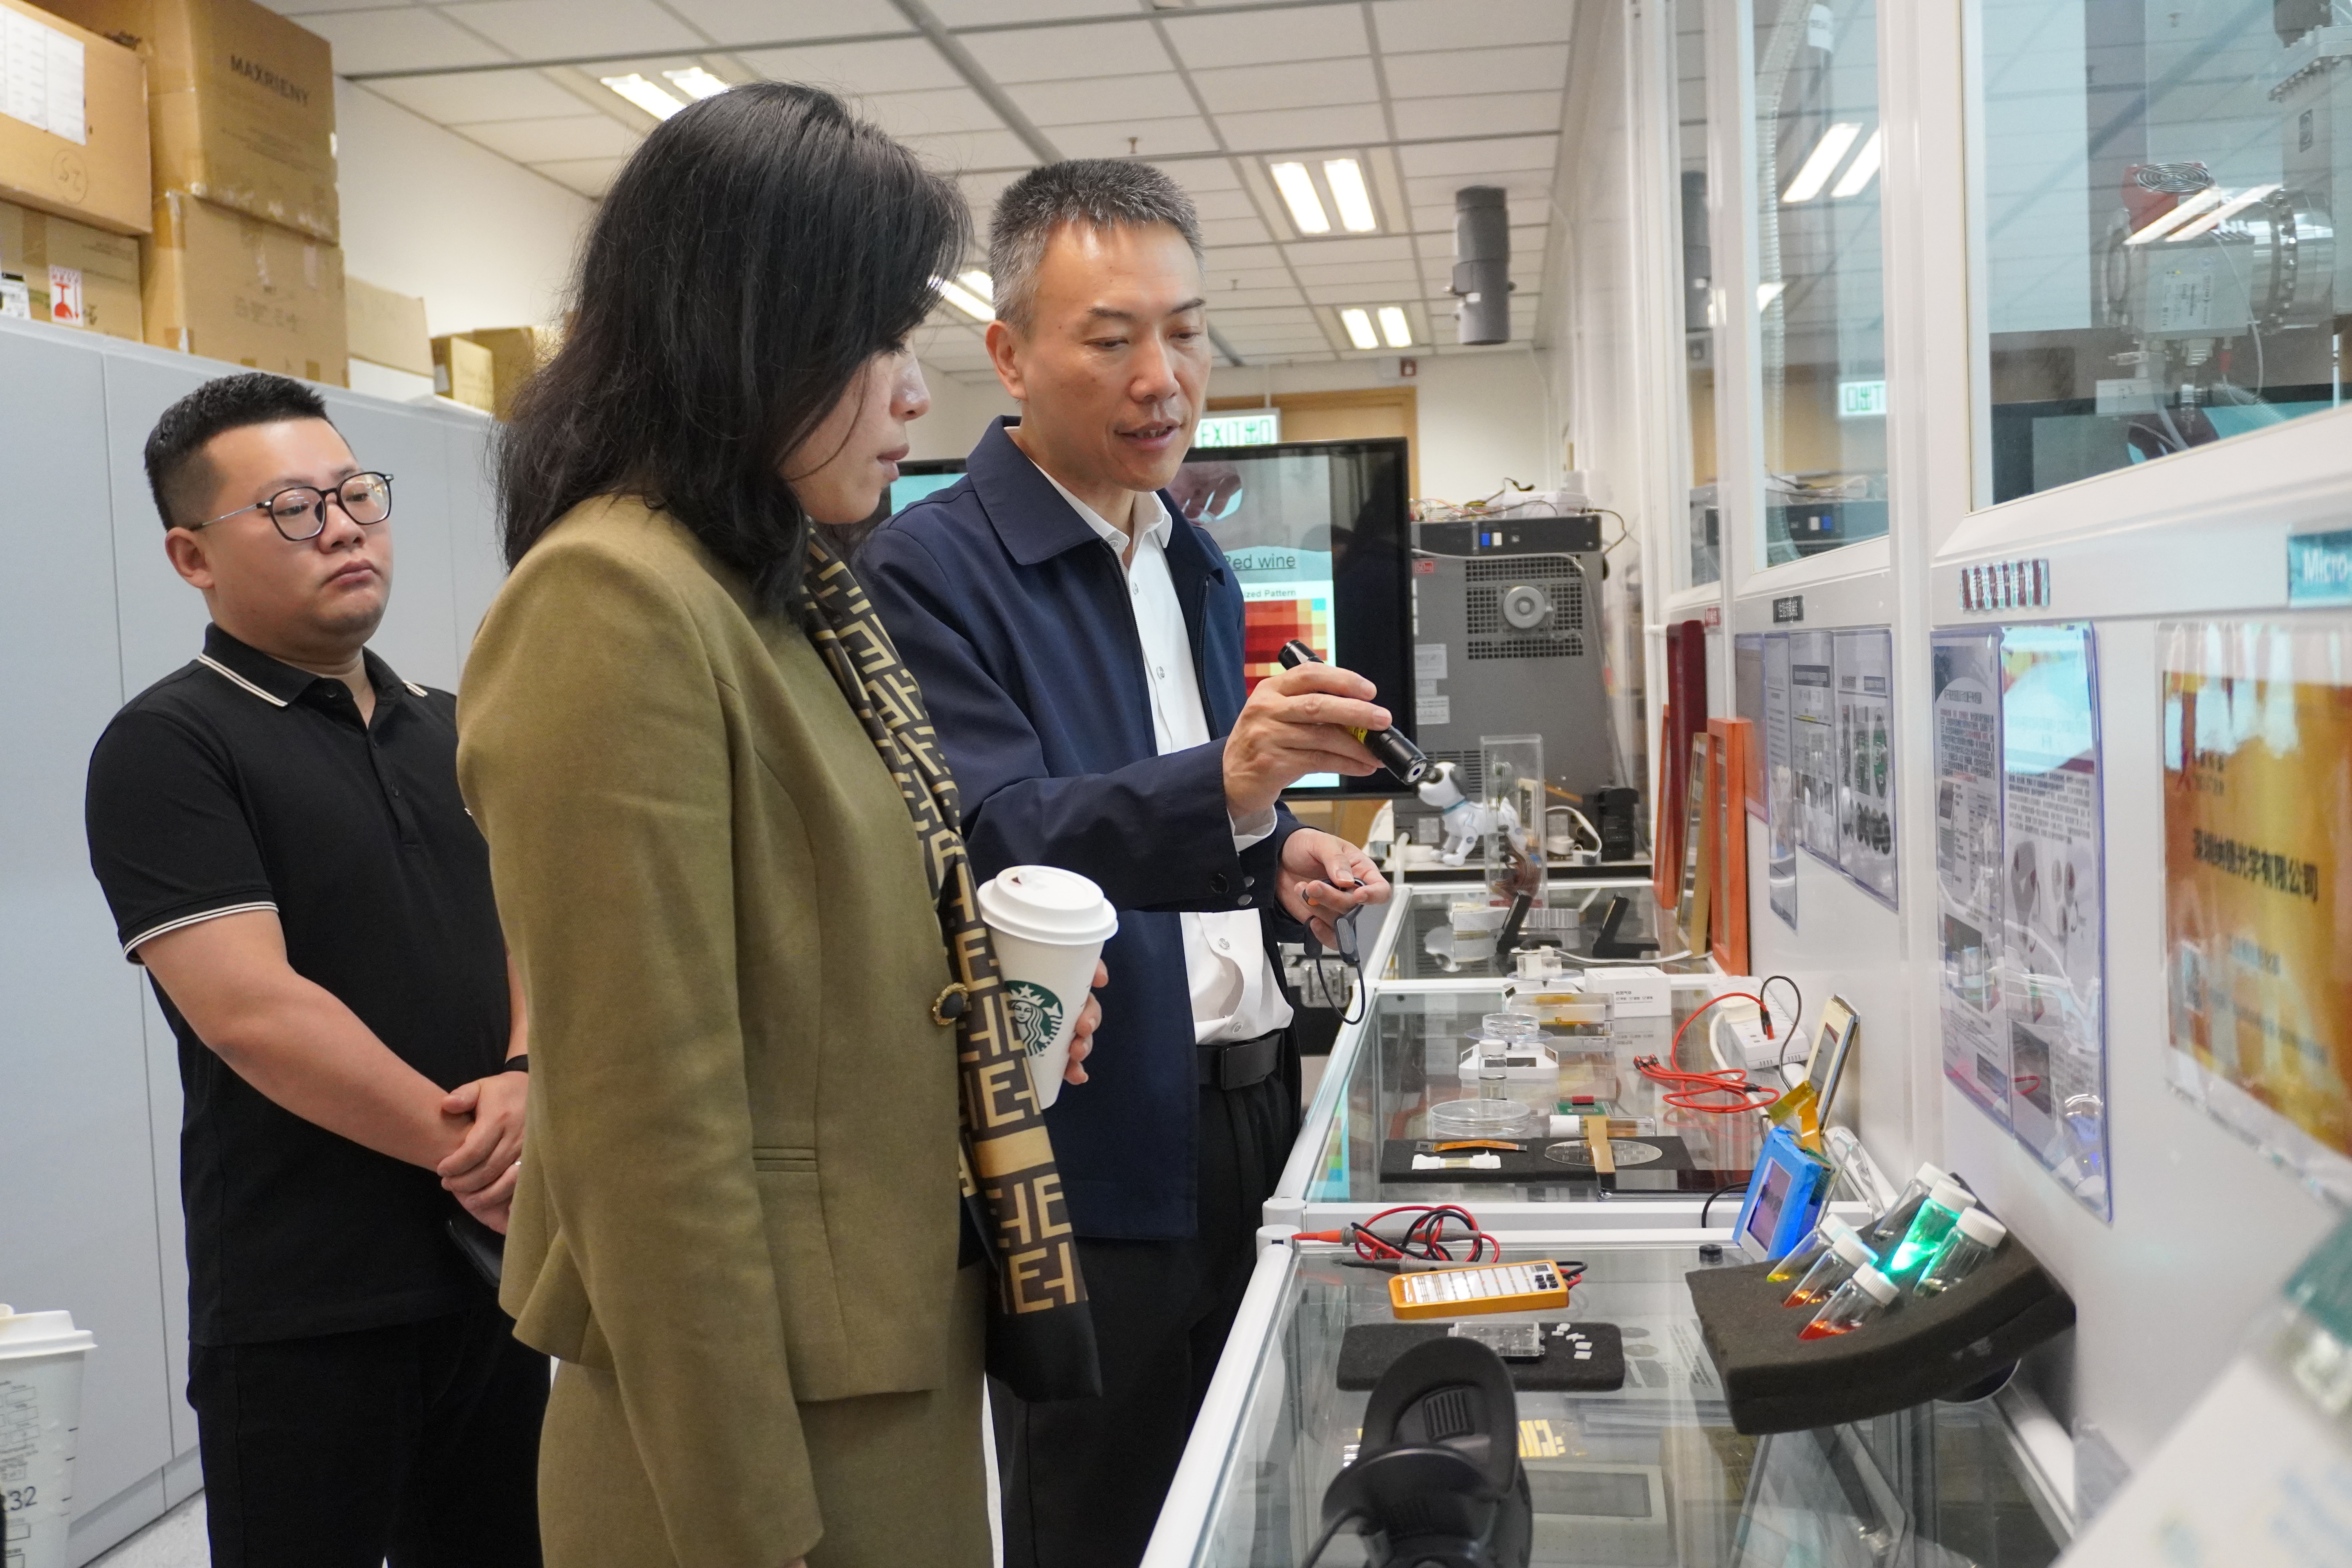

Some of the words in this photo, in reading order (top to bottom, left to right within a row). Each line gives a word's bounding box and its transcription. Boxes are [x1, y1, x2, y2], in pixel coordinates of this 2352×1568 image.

[1201, 421, 1243, 447] EXIT
[1245, 419, 1271, 443] 出口
[1258, 553, 1296, 568] wine
